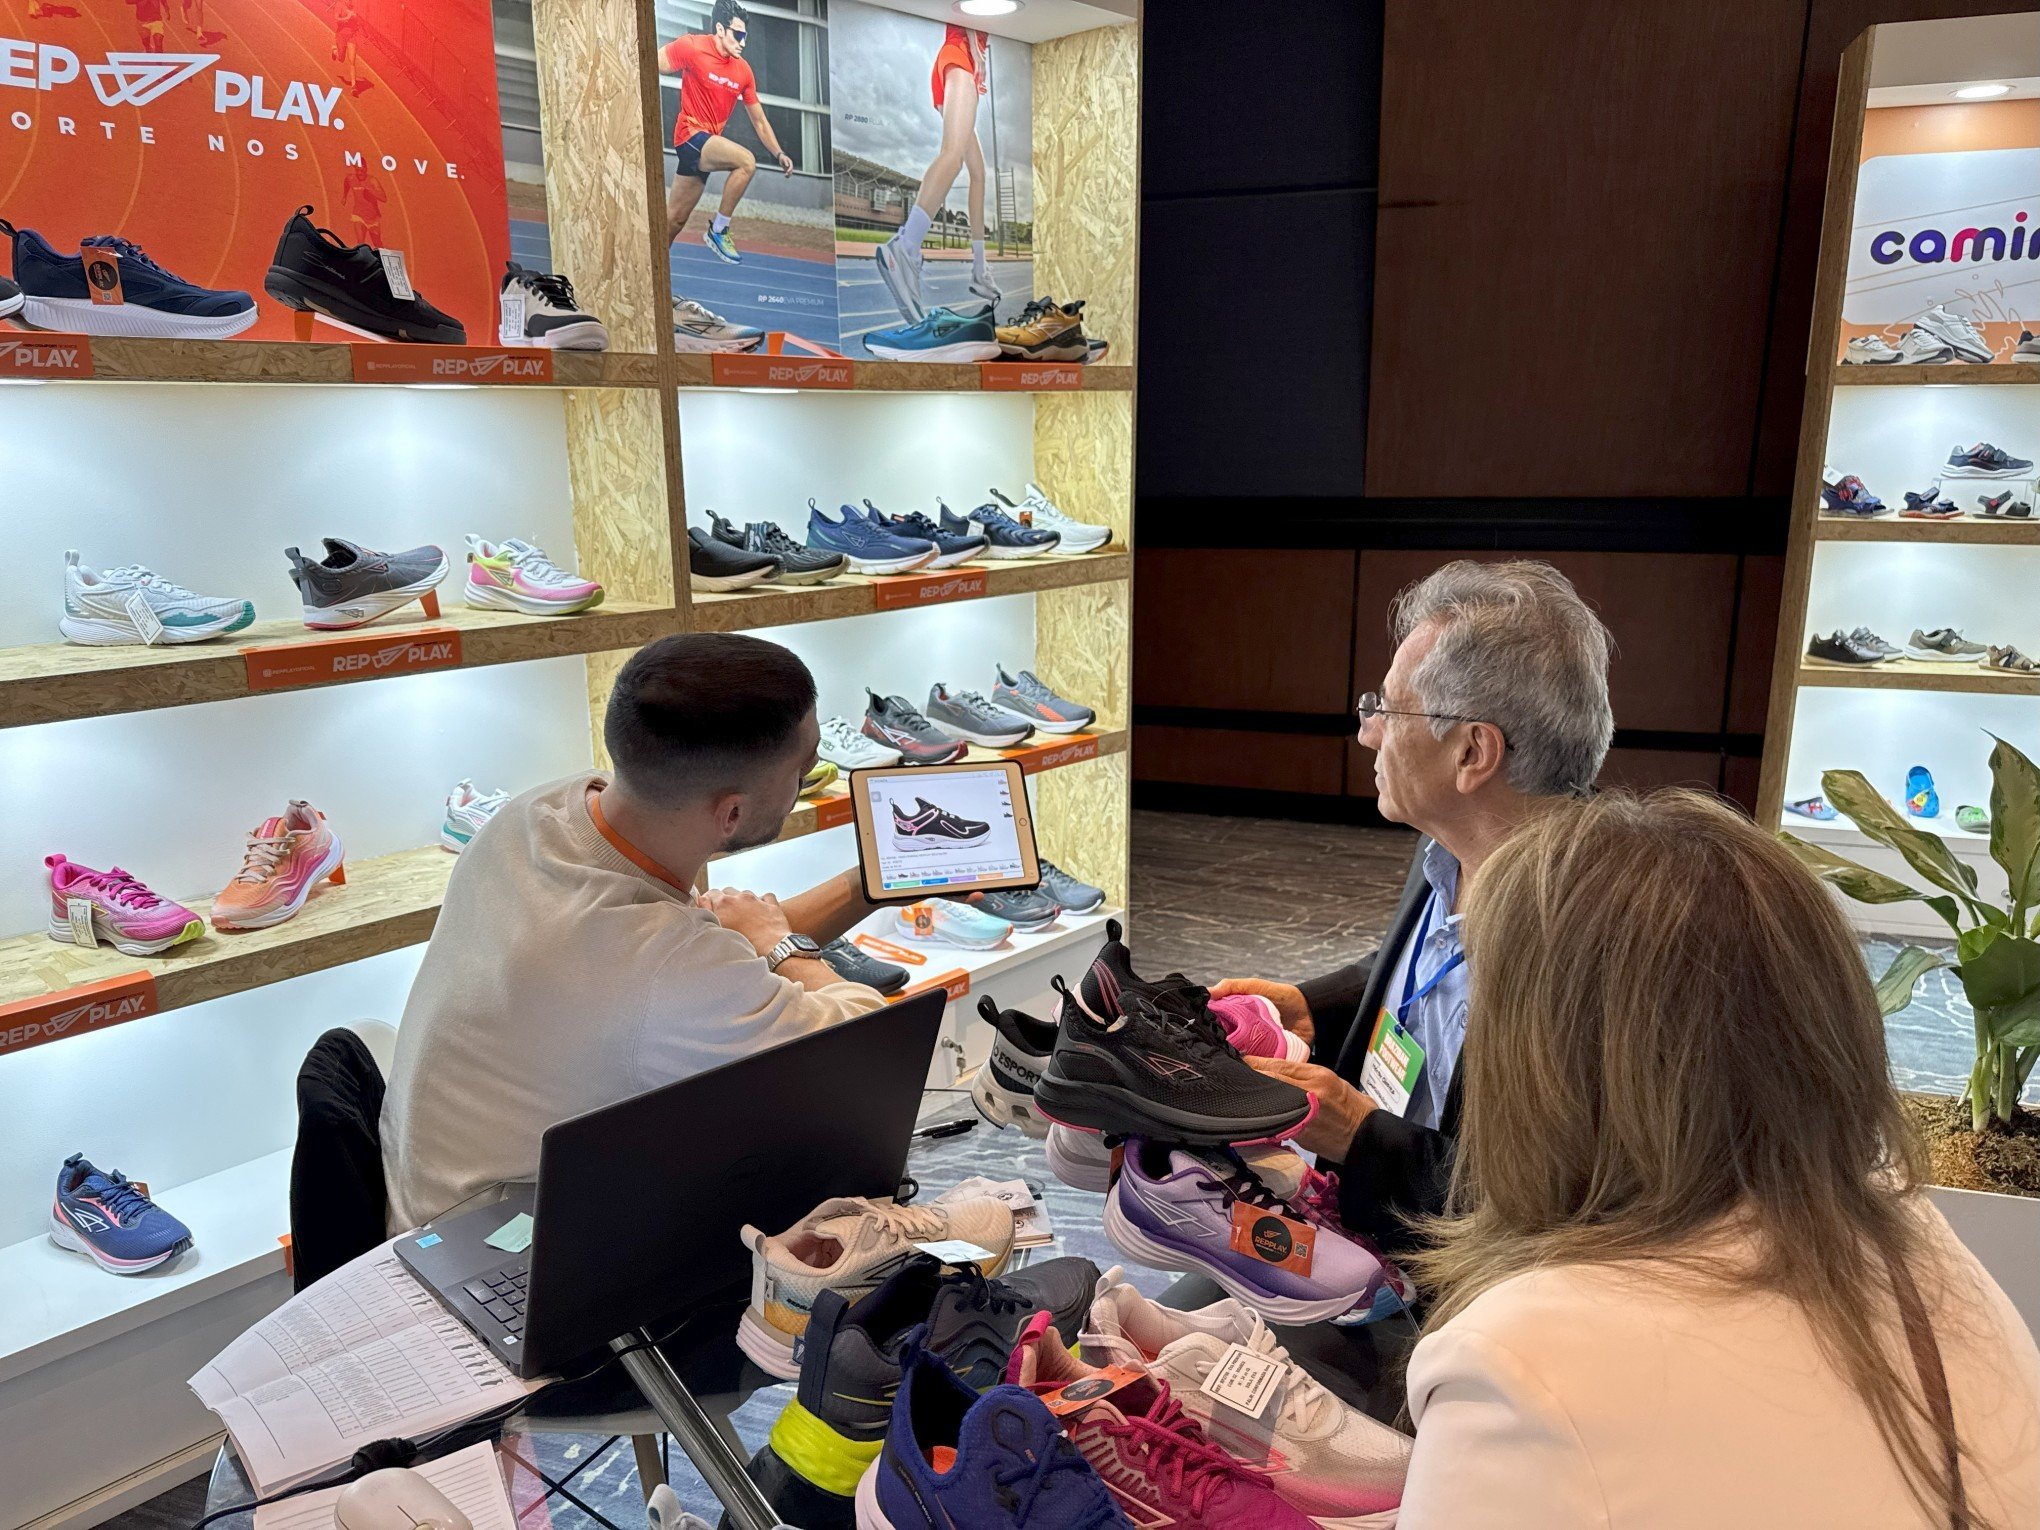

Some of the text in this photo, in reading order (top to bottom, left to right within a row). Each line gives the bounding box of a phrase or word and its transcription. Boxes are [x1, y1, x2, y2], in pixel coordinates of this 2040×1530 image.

[214, 69, 345, 130] PLAY.
[208, 134, 299, 160] NOS
[344, 150, 465, 180] MOVE.
[15, 348, 80, 369] PLAY.
[432, 358, 545, 376] REP PLAY.
[769, 366, 848, 383] REP PLAY.
[1021, 372, 1039, 385] REP
[920, 580, 982, 598] REP PLAY.
[333, 643, 453, 672] REP PLAY.
[1042, 753, 1059, 767] REP
[89, 995, 146, 1024] PLAY.
